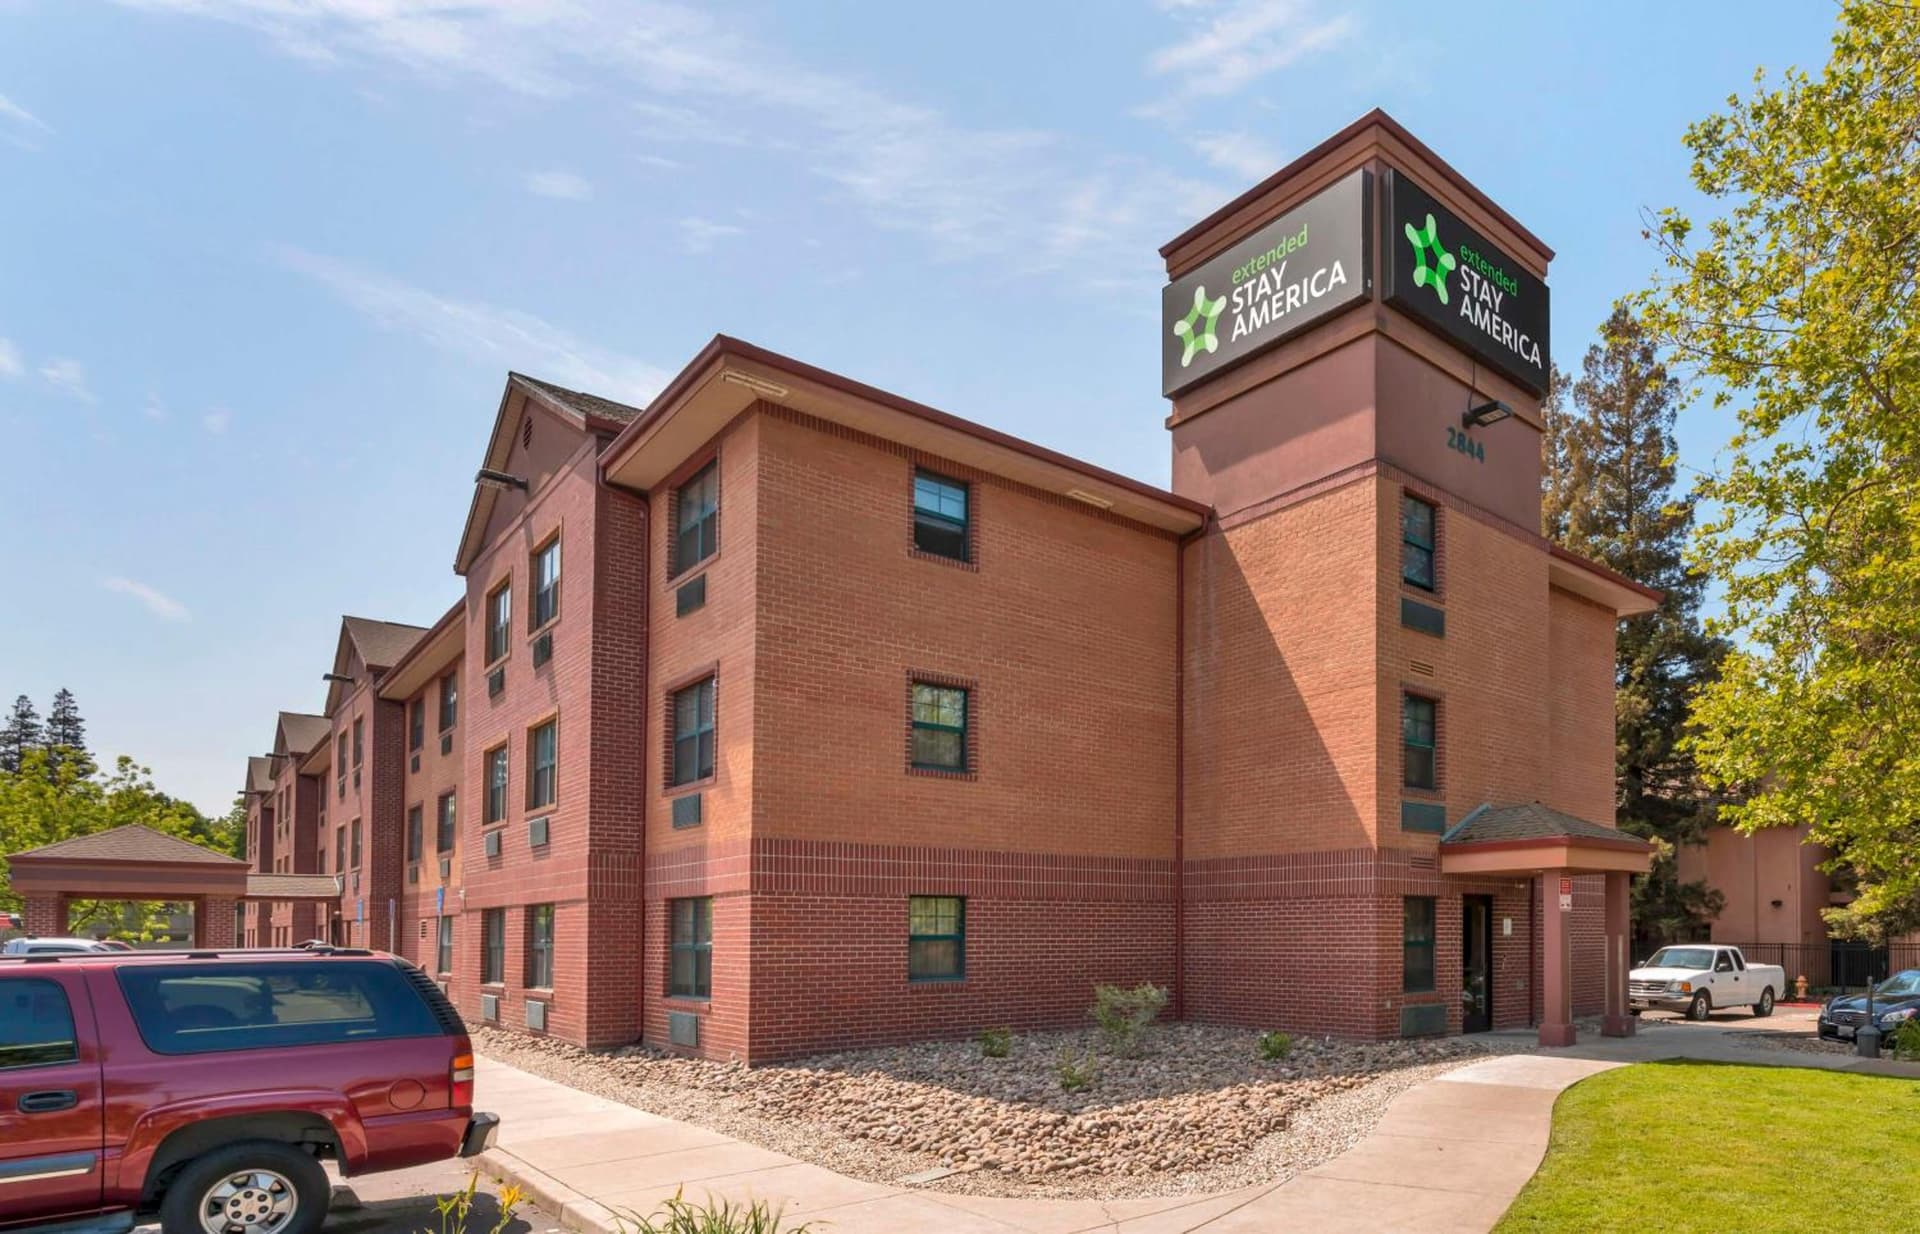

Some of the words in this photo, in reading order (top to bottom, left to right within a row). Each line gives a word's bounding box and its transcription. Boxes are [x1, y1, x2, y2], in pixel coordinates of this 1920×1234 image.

[1232, 223, 1308, 284] extended
[1460, 245, 1517, 297] extended
[1231, 259, 1347, 343] AMERICA
[1232, 260, 1288, 314] STAY
[1460, 264, 1503, 313] STAY
[1460, 294, 1542, 369] AMERICA
[1447, 426, 1485, 464] 2844
